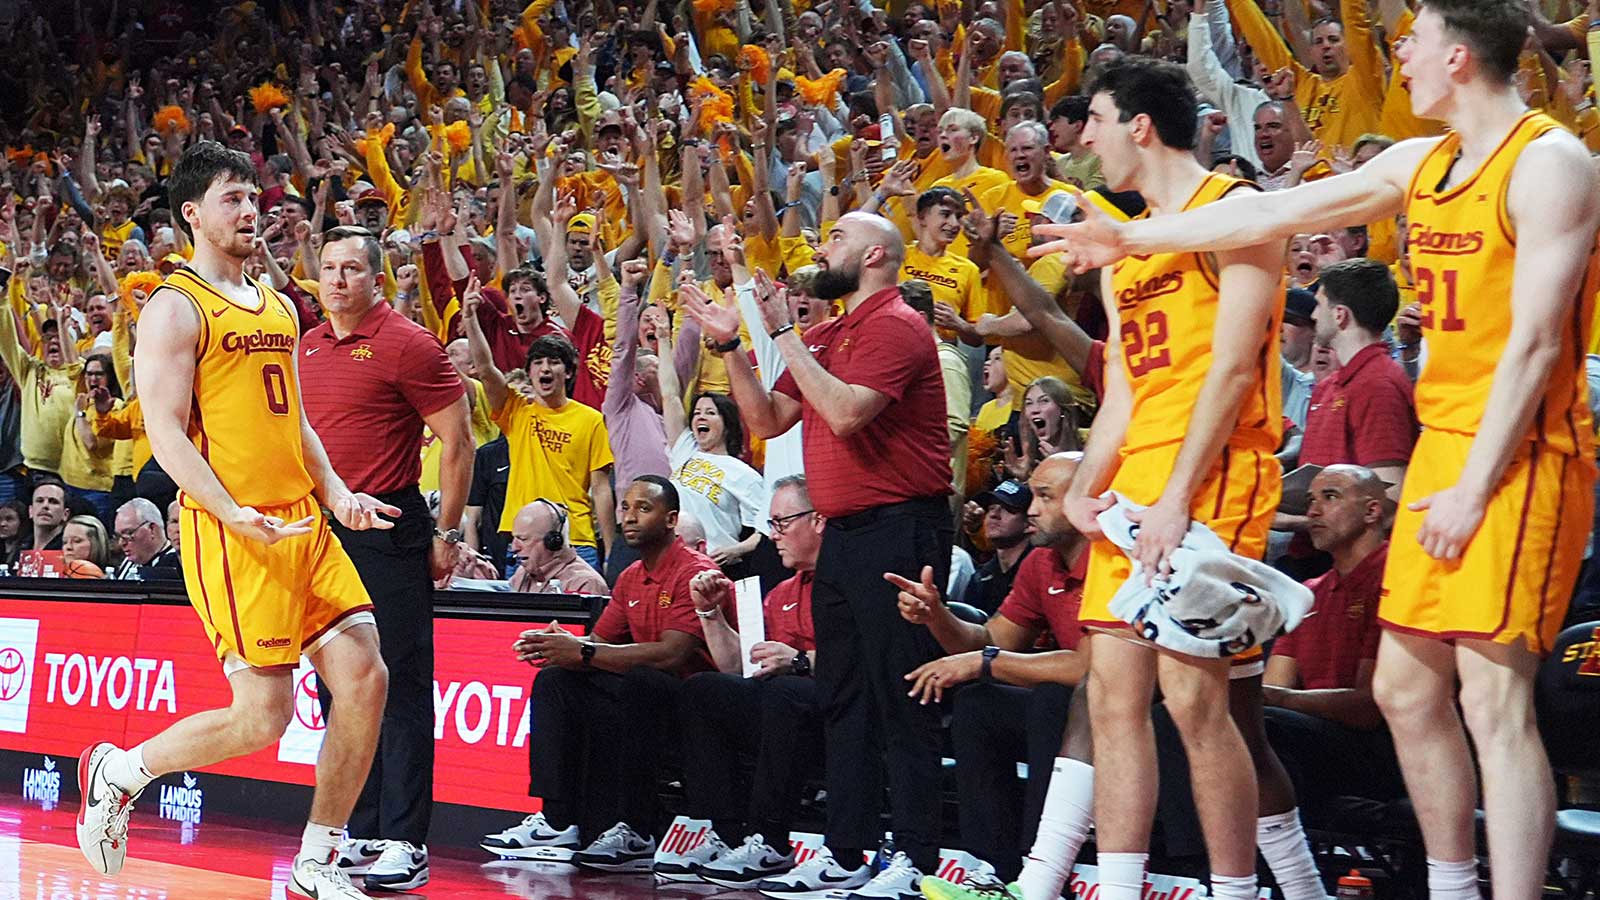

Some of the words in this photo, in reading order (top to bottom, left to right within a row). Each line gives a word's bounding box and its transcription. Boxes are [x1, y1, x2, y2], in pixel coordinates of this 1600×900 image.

[1114, 271, 1184, 310] clones
[1416, 267, 1464, 331] 21
[1121, 311, 1171, 378] 22
[262, 364, 289, 415] 0
[44, 653, 177, 713] TOYOTA
[23, 768, 60, 788] LANDUS
[160, 785, 202, 808] LANDUS
